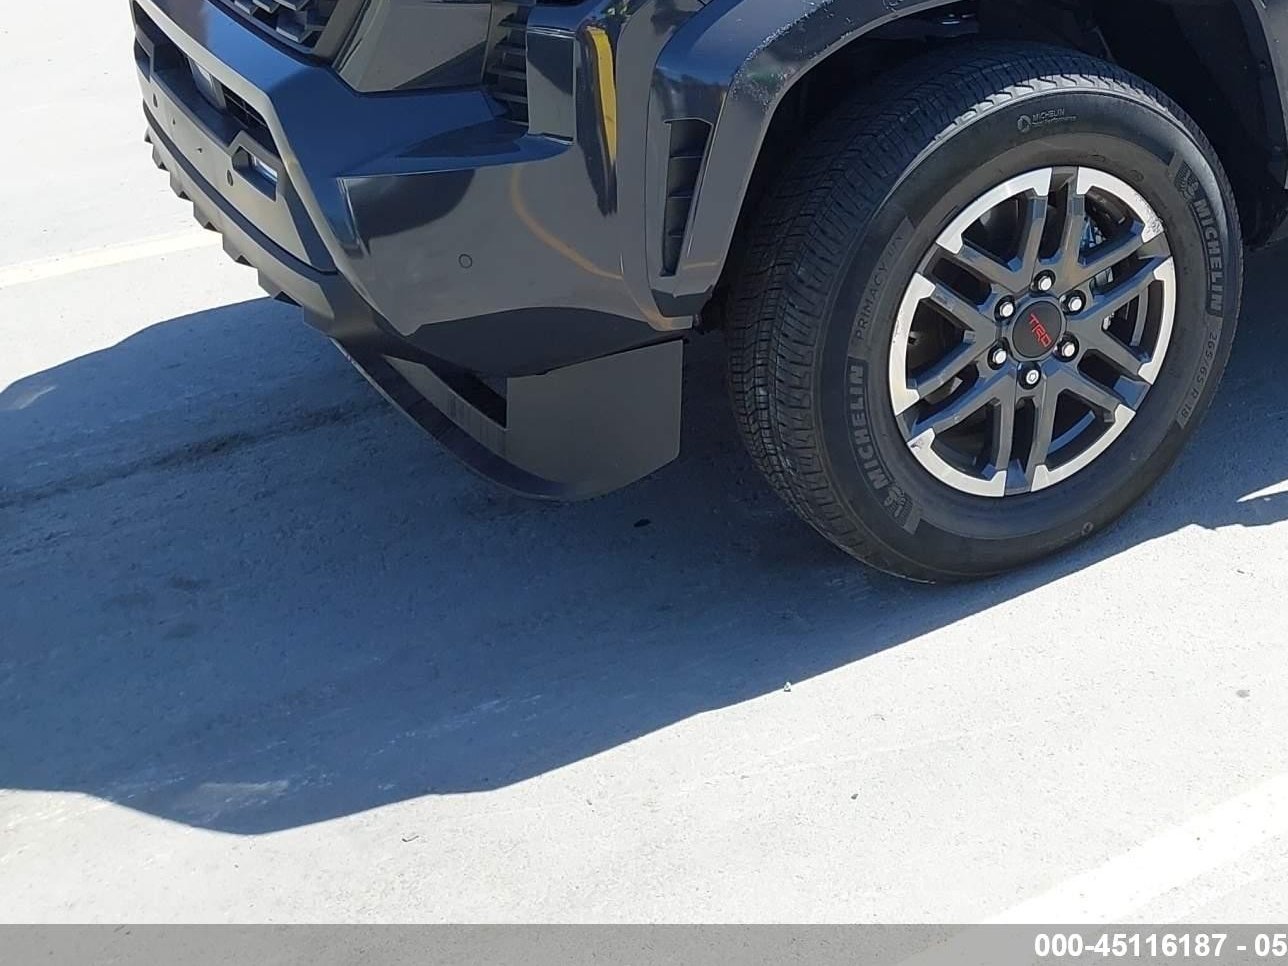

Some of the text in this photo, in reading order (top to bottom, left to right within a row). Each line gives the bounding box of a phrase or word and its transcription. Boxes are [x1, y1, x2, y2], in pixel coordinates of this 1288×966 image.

[1032, 107, 1065, 122] MICHELIN
[1194, 198, 1224, 312] MICHELIN
[855, 261, 888, 340] PRIMACY
[1029, 313, 1052, 347] TRD
[1196, 332, 1218, 387] 265/65
[850, 365, 889, 490] MICHELIN
